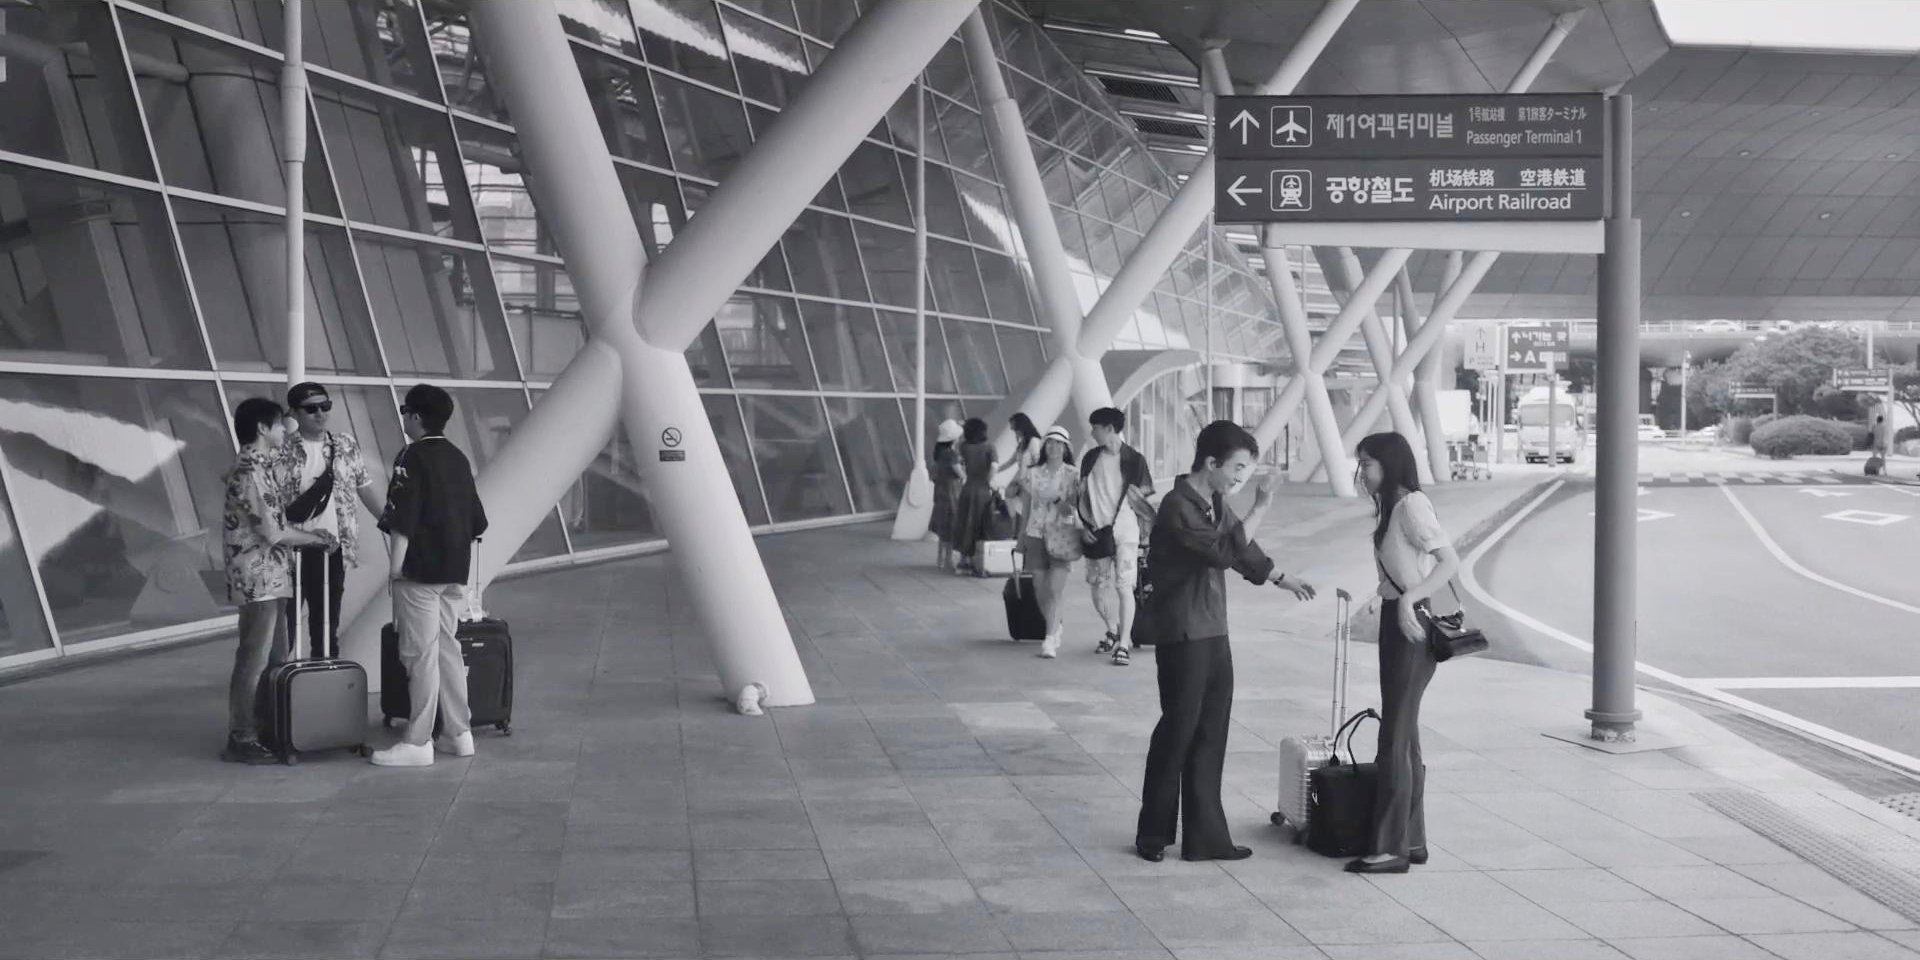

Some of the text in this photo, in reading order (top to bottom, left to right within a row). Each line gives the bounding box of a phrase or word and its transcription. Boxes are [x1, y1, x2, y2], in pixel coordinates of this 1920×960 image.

[1326, 113, 1454, 139] 제1여객터미널
[1466, 129, 1582, 148] Passenger Terminal 1
[1429, 168, 1495, 187] 机场铁路
[1520, 168, 1586, 187] 空港鉄道
[1326, 176, 1415, 204] 공항철도
[1429, 193, 1571, 214] Airport Railroad
[1524, 350, 1537, 364] A
